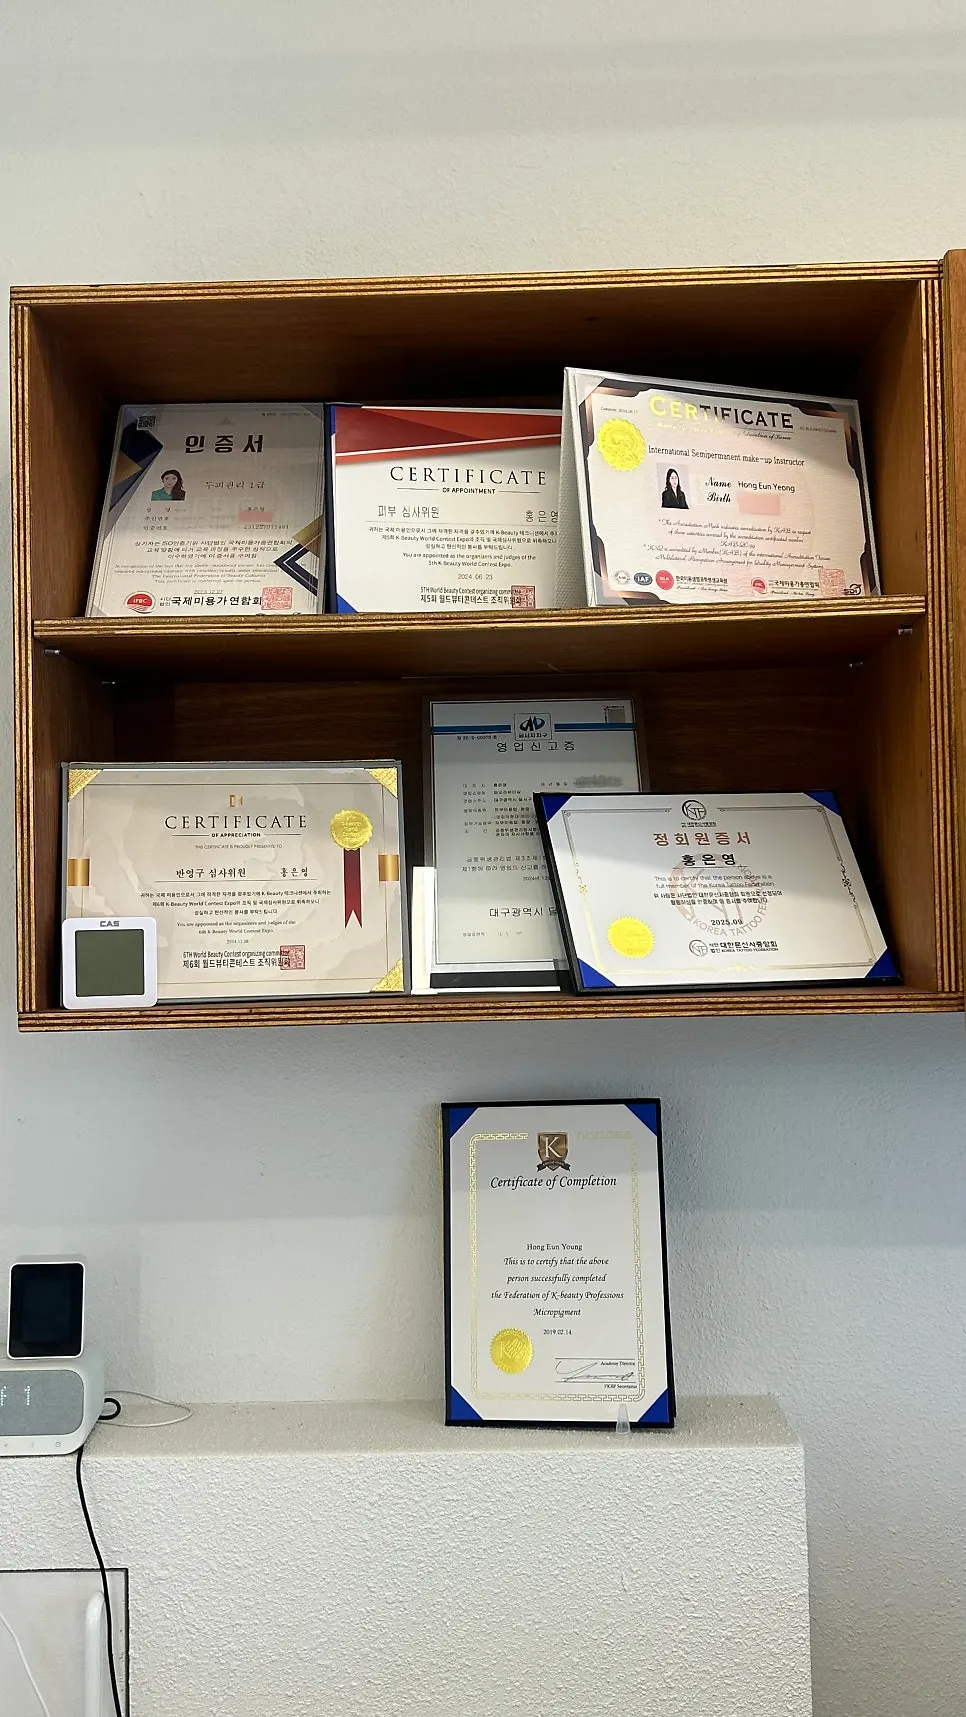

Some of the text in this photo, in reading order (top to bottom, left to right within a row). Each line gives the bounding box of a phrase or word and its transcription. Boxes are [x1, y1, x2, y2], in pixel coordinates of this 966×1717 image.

[649, 394, 794, 430] CERTIFICATE
[185, 434, 264, 454] 인증서
[648, 445, 805, 467] International Semipermanent make-up Instructor
[390, 466, 547, 486] CERTIFICATE
[451, 487, 496, 495] APPOINTMENT
[705, 476, 796, 494] Name Hong Eun Yeong
[707, 491, 731, 503] Birth
[378, 505, 396, 518] 피부
[402, 506, 440, 519] 심사위원
[443, 587, 459, 595] Beauty
[475, 588, 499, 596] organizing
[170, 596, 262, 607] 국제미용가연합회
[496, 741, 575, 753] 영업신고증
[164, 815, 307, 830] CERTIFICATE
[653, 831, 751, 847] 정회원증서
[681, 853, 736, 867] 홍은영
[176, 866, 308, 879] 반영구 심사위원 홍은영
[489, 907, 543, 918] 대구광역시
[99, 920, 120, 928] CAS
[693, 915, 763, 937] KOREA TATTOO
[719, 940, 778, 949] 대한문신사중앙회
[207, 951, 224, 959] Beauty
[223, 950, 242, 958] Contest
[241, 950, 266, 959] organizing
[182, 959, 201, 969] 제6회
[202, 958, 256, 969] 월드뷰티콘테스트
[544, 1136, 563, 1158] K
[490, 1174, 617, 1191] Certificate of Completion
[526, 1243, 583, 1252] Hong Eun Young
[503, 1256, 610, 1268] This is to certify that the above
[506, 1273, 608, 1285] person successfully completed
[491, 1290, 625, 1302] the Federation of K-beauty Professions
[533, 1308, 582, 1319] Micropigment
